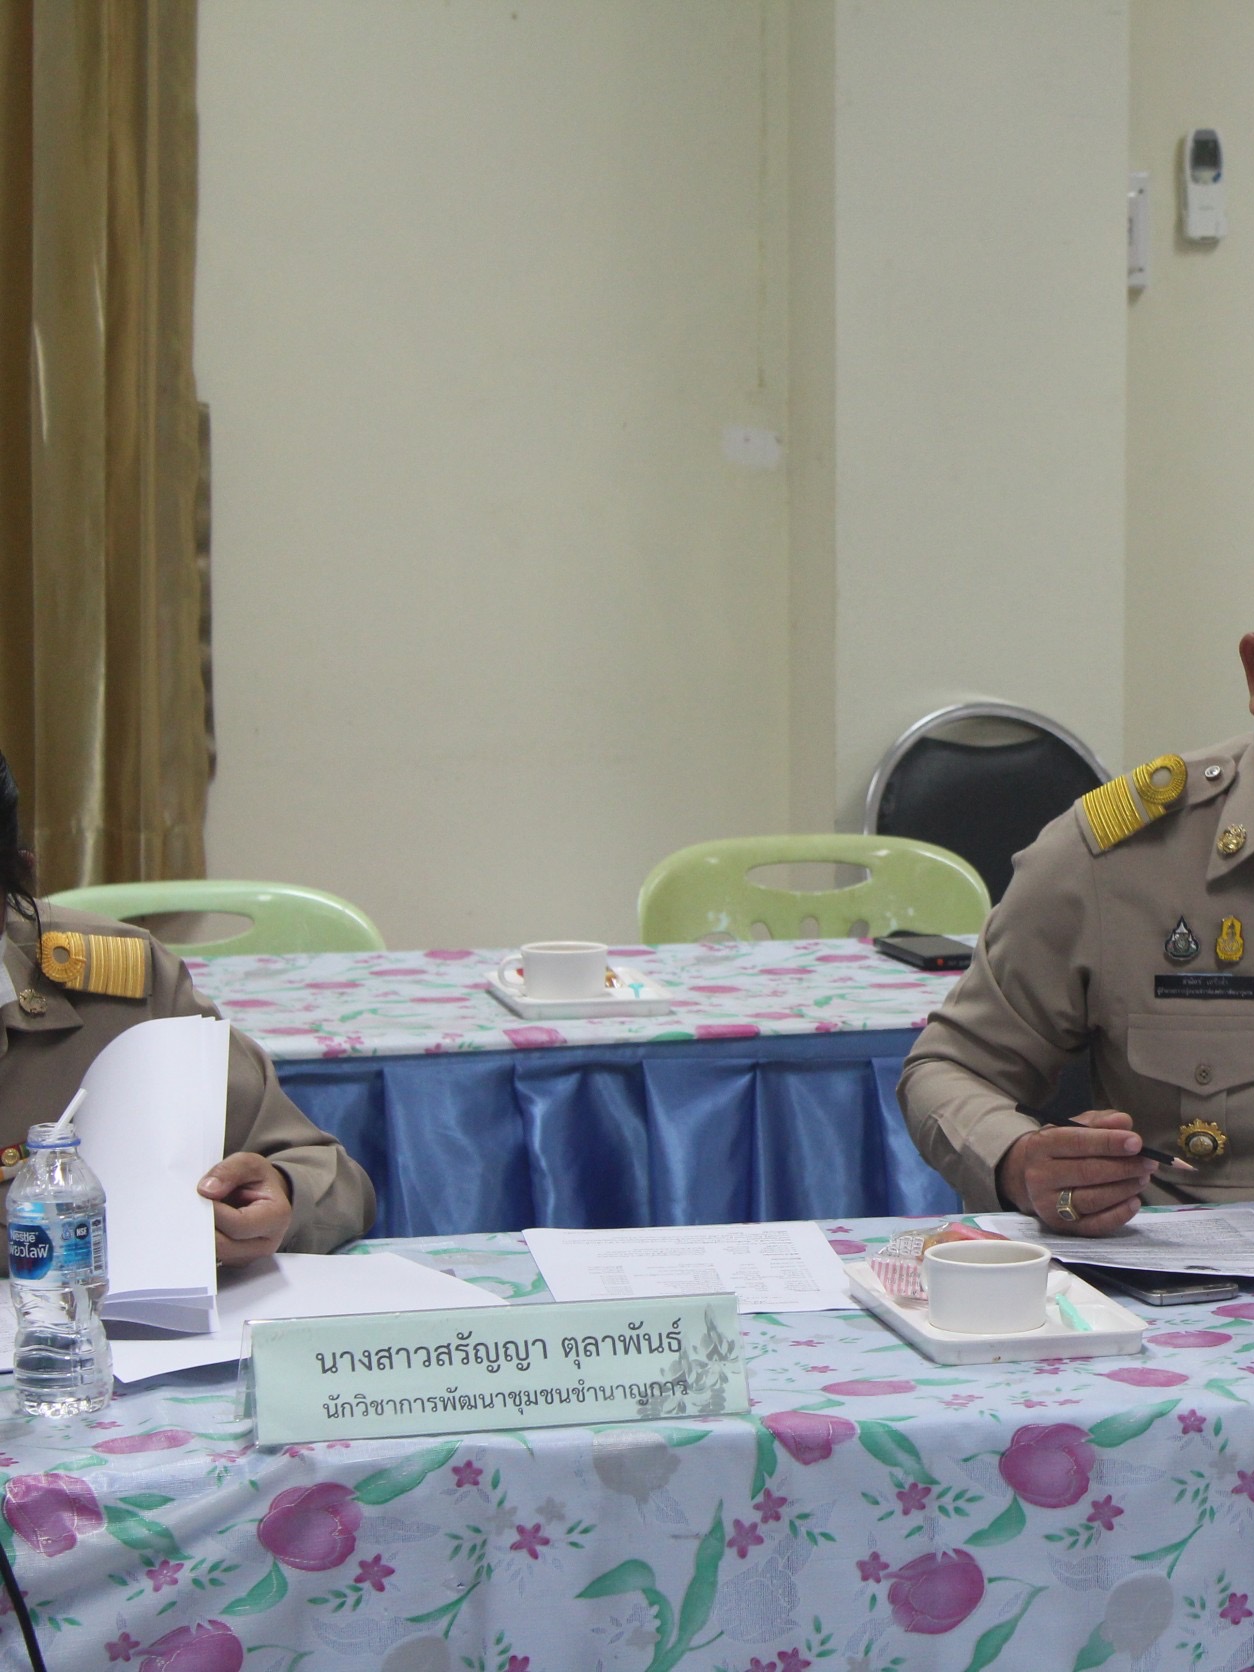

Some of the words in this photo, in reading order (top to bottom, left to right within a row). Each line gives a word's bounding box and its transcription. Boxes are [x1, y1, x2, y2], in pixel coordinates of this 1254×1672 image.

[76, 1226, 87, 1237] NSF
[315, 1330, 548, 1374] นางสาวสรัญญา
[560, 1317, 682, 1370] ตุลาพันธ์
[322, 1379, 689, 1419] นักวิชาการพัฒนาชุมชนชำนาญการ
